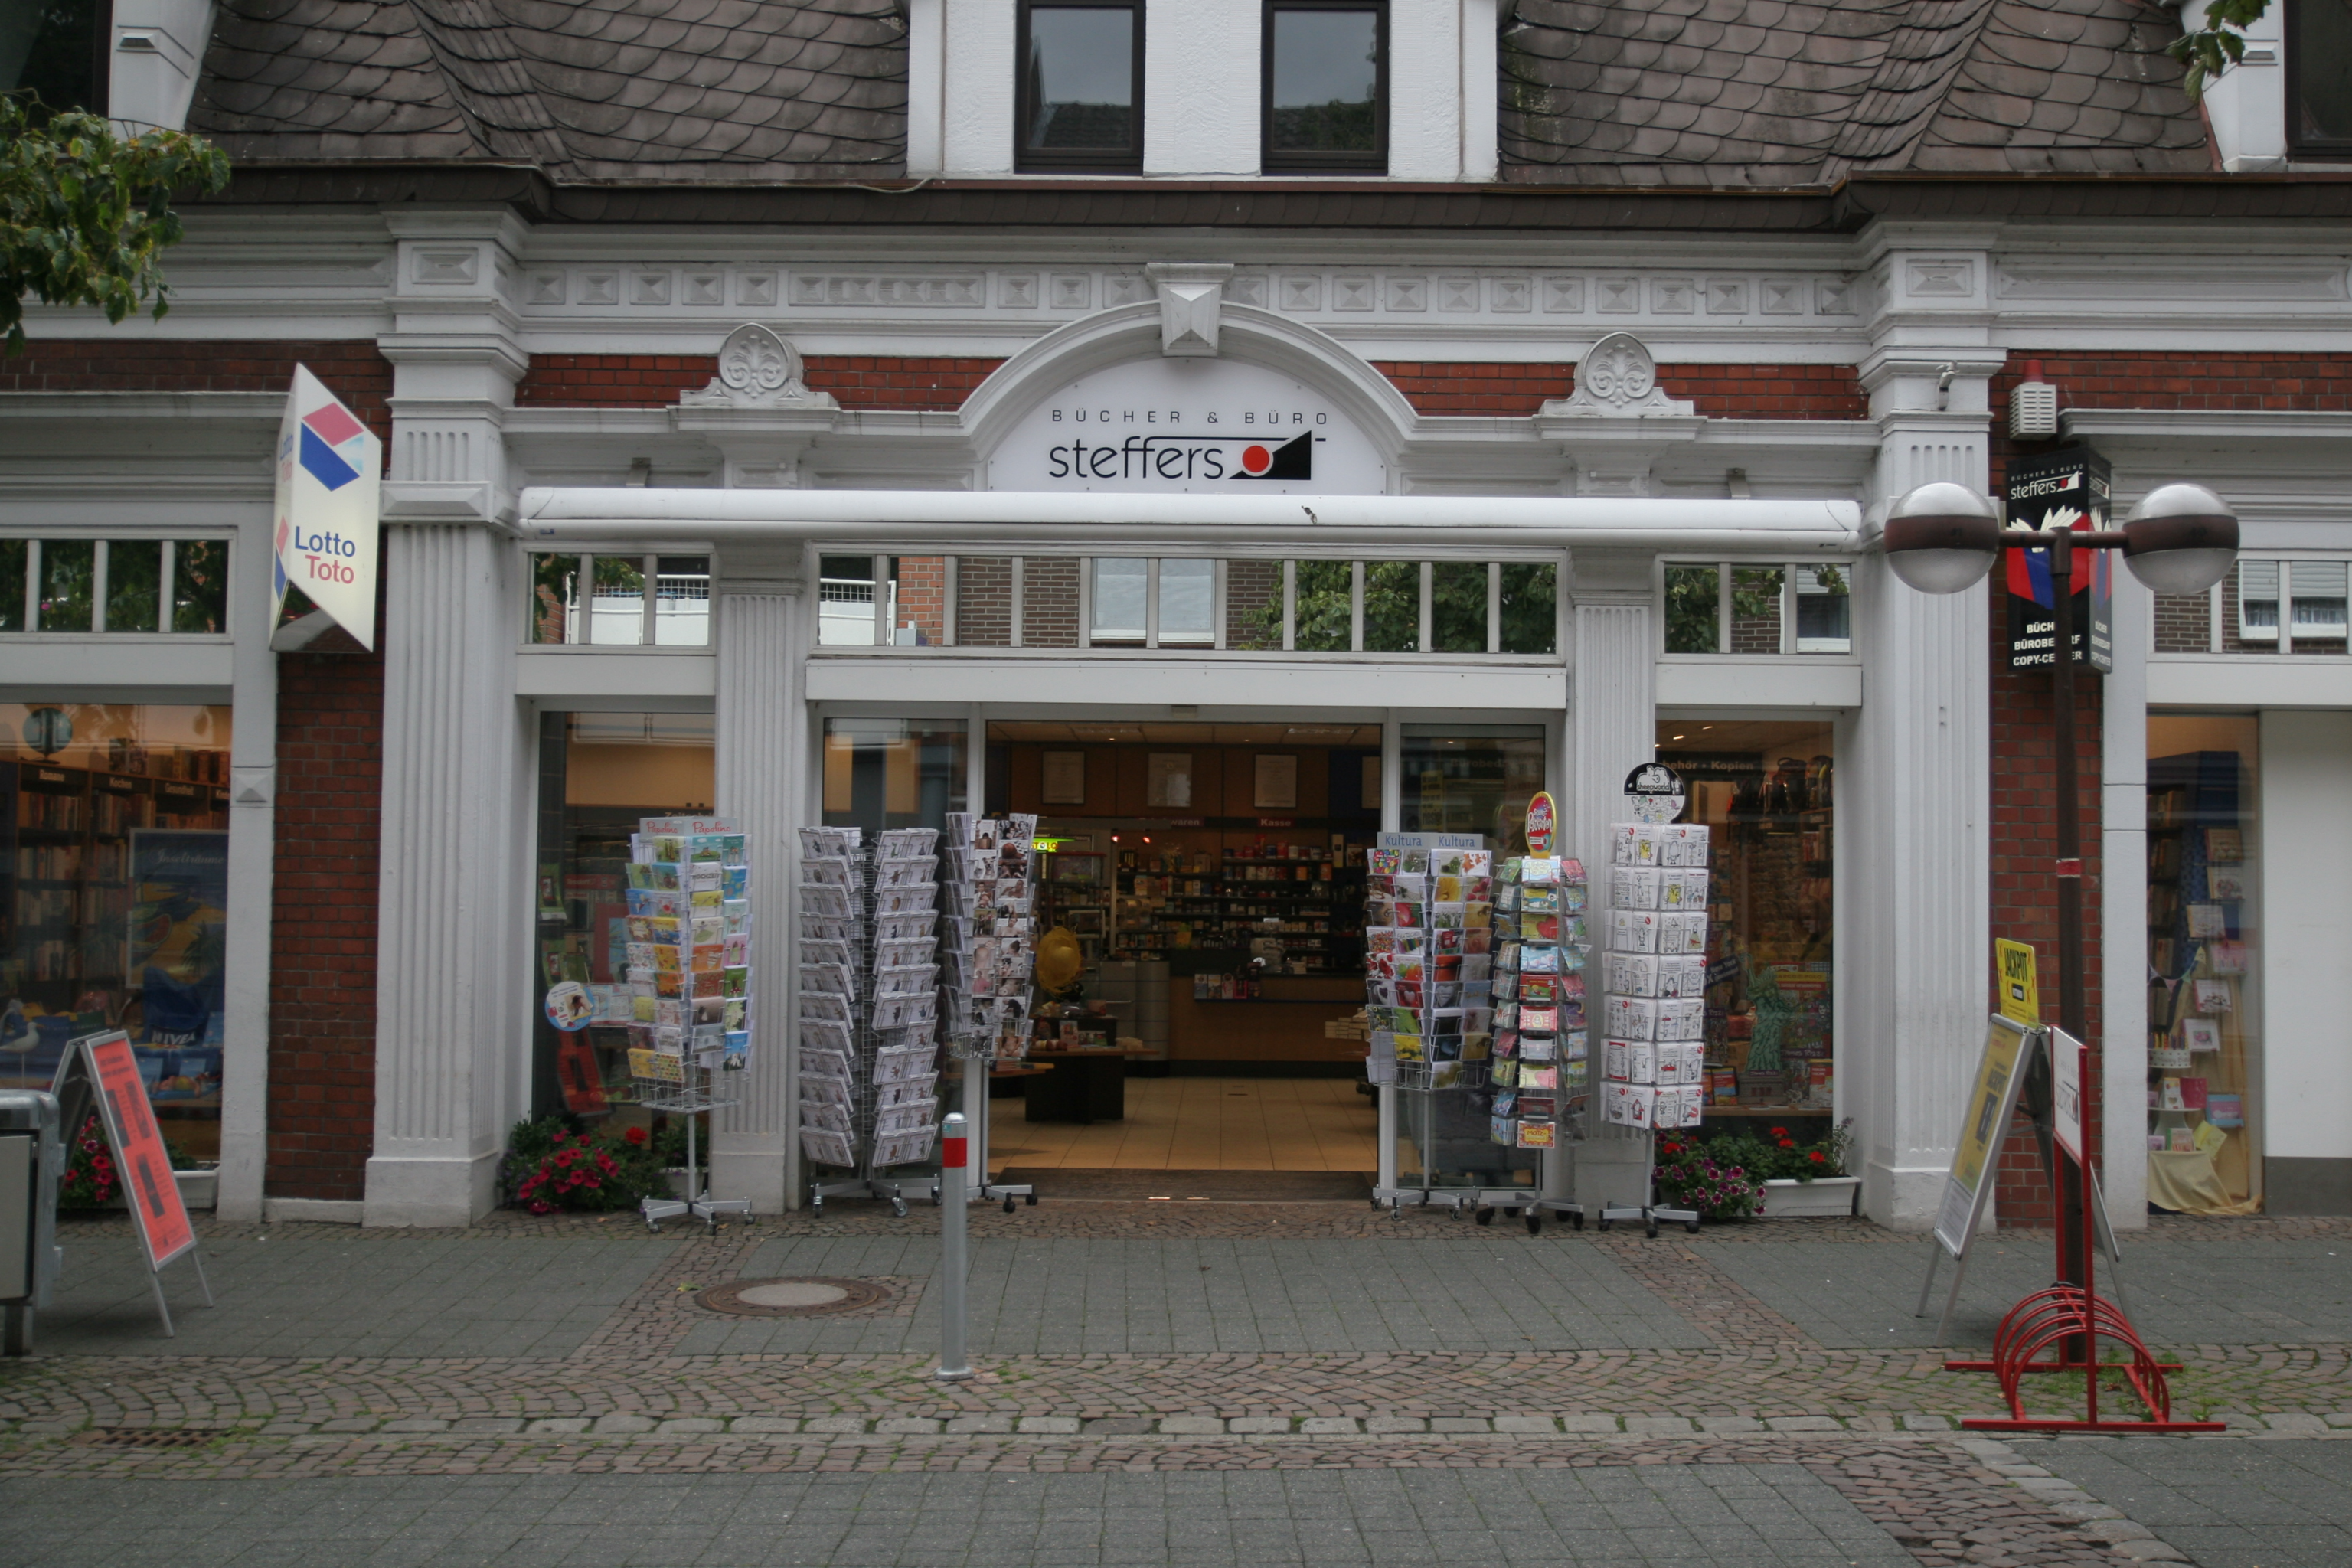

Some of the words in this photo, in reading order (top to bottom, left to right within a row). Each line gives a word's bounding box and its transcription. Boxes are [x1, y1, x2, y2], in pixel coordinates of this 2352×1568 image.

[1052, 407, 1181, 423] BÜCHER
[1207, 412, 1218, 423] &
[1245, 409, 1328, 425] BÜRO
[1048, 436, 1224, 479] steffers
[2011, 469, 2046, 482] BÜCHER
[2060, 463, 2083, 473] BÜRO
[2011, 481, 2057, 500] steffers
[295, 525, 356, 557] Lotto
[305, 554, 354, 584] Toto
[2026, 621, 2055, 634] BÜCH
[1710, 761, 1754, 772] Kopien
[109, 776, 132, 790] Kochen
[1636, 783, 1670, 794] sheepworld
[646, 821, 678, 834] Papelino
[692, 821, 731, 835] Papelino
[1260, 818, 1292, 827] Kasse
[1385, 835, 1423, 847] Kultura
[1439, 835, 1475, 848] Kultura
[2004, 946, 2028, 983] JACKPOT
[151, 1030, 196, 1044] NIVEA
